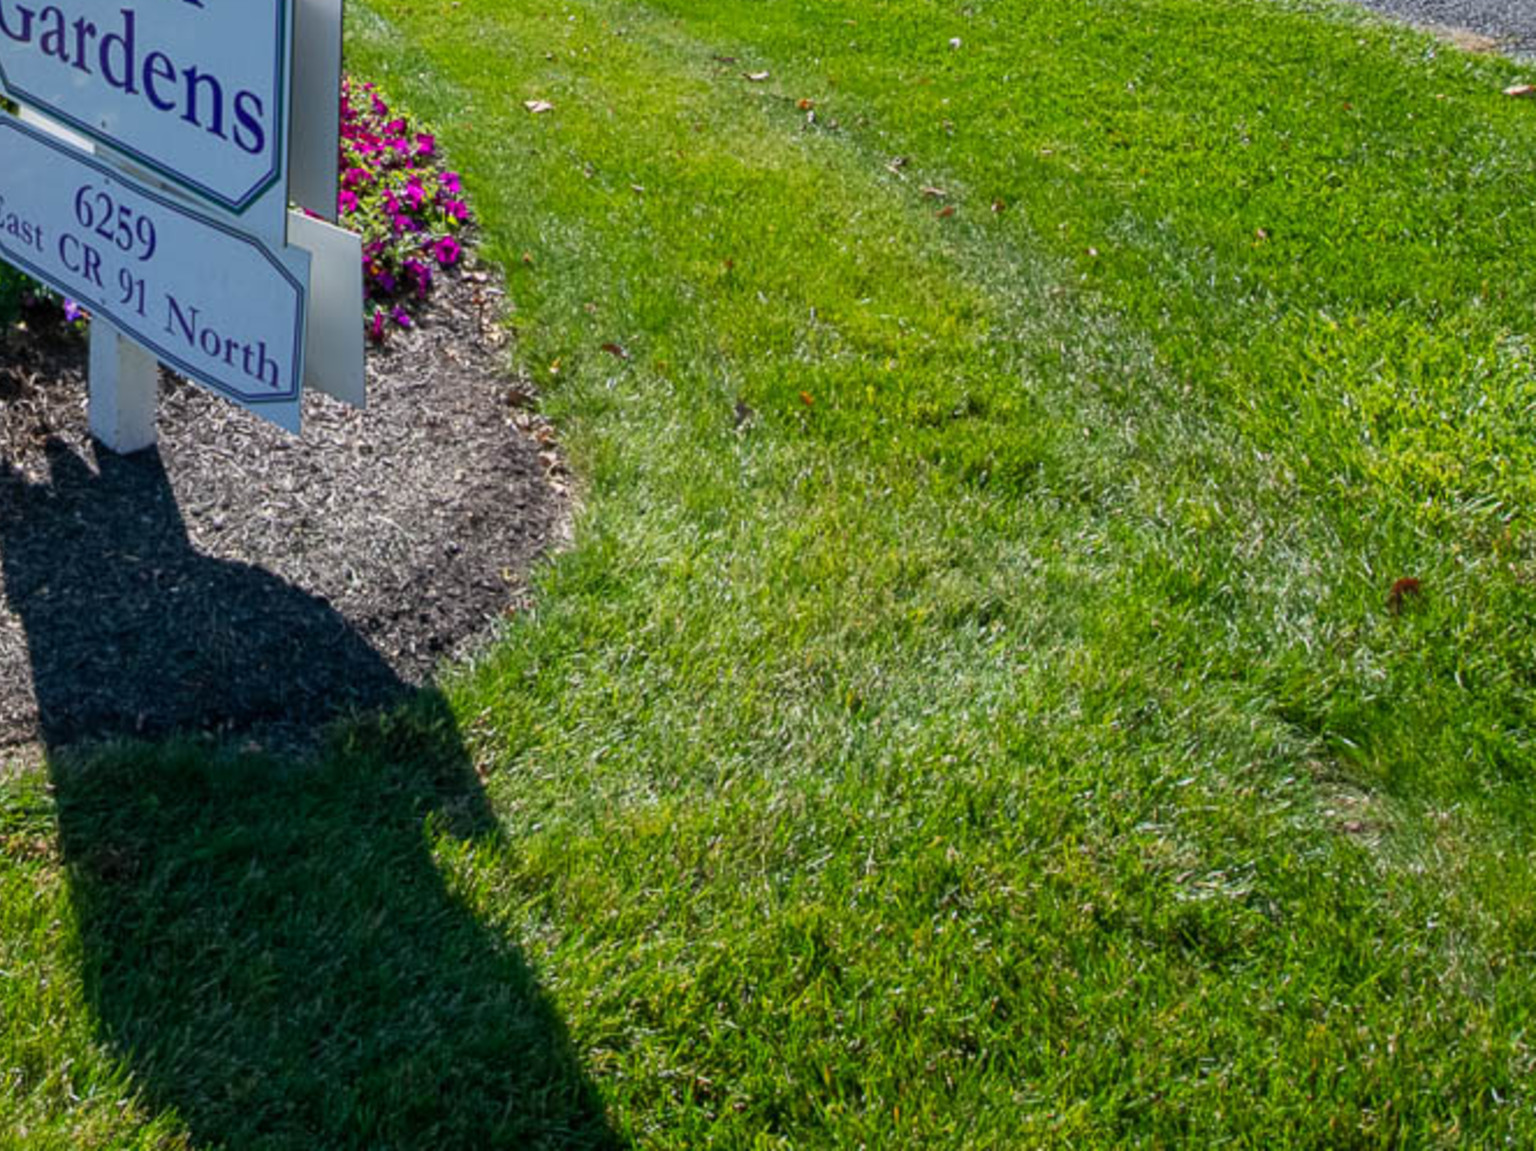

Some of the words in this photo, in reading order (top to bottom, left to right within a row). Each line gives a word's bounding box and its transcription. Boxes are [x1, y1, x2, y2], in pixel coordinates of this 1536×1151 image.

[75, 183, 157, 261] 6259
[59, 235, 103, 287] CR
[118, 266, 147, 317] 91
[166, 294, 280, 389] North
